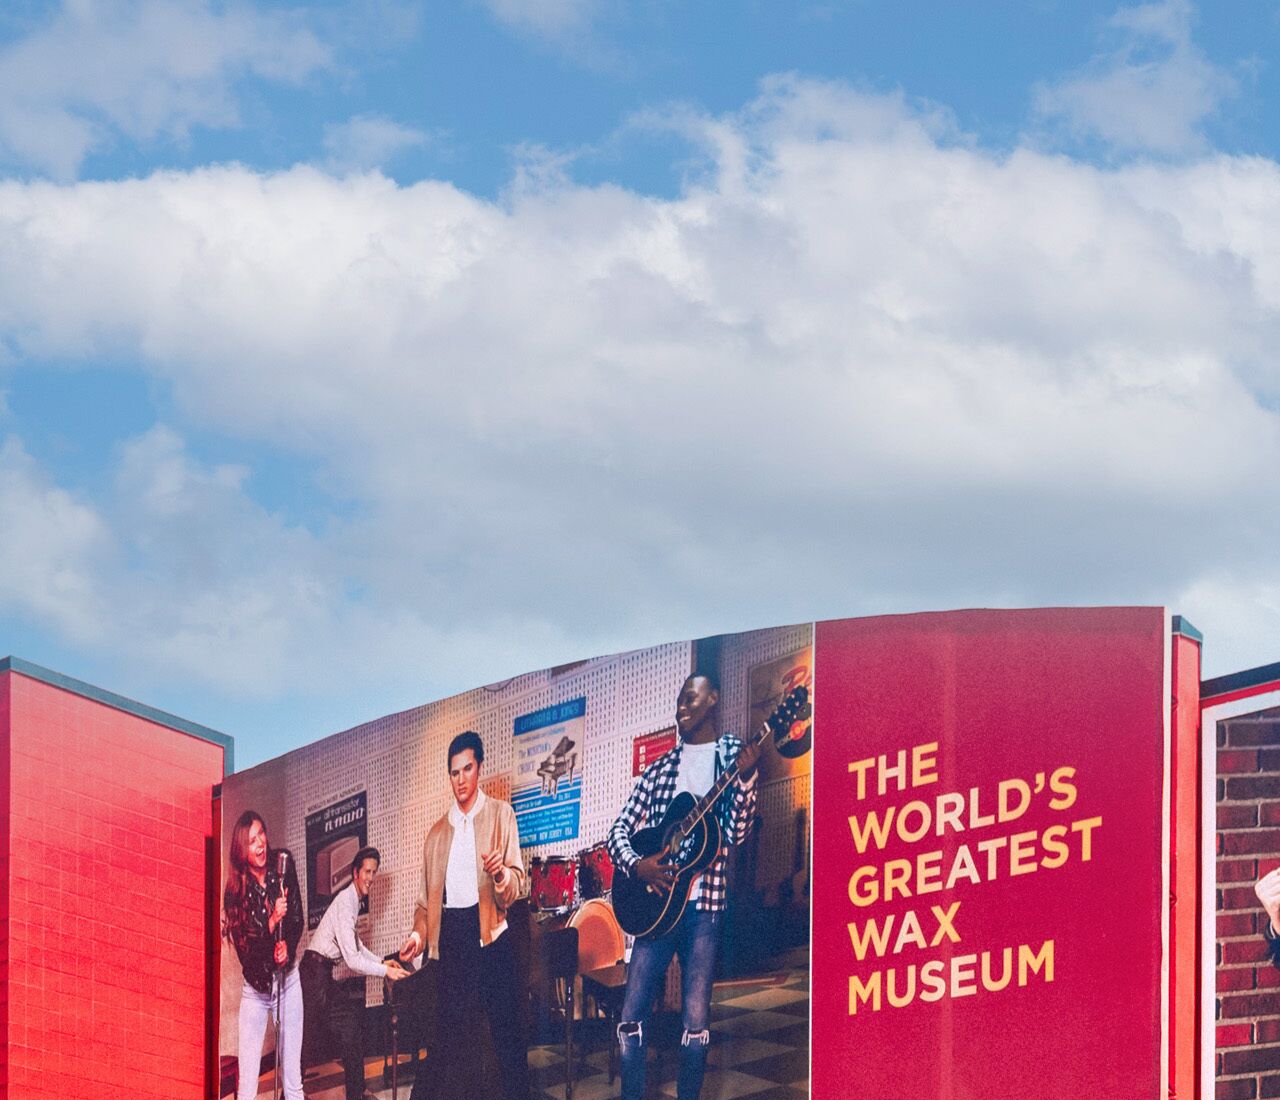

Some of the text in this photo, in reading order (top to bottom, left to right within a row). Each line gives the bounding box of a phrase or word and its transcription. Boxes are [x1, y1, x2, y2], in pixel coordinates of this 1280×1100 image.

[847, 741, 939, 800] THE
[847, 765, 1078, 854] WORLD'S
[847, 816, 1103, 907] GREATEST
[847, 901, 962, 961] WAX
[848, 939, 1055, 1016] MUSEUM
